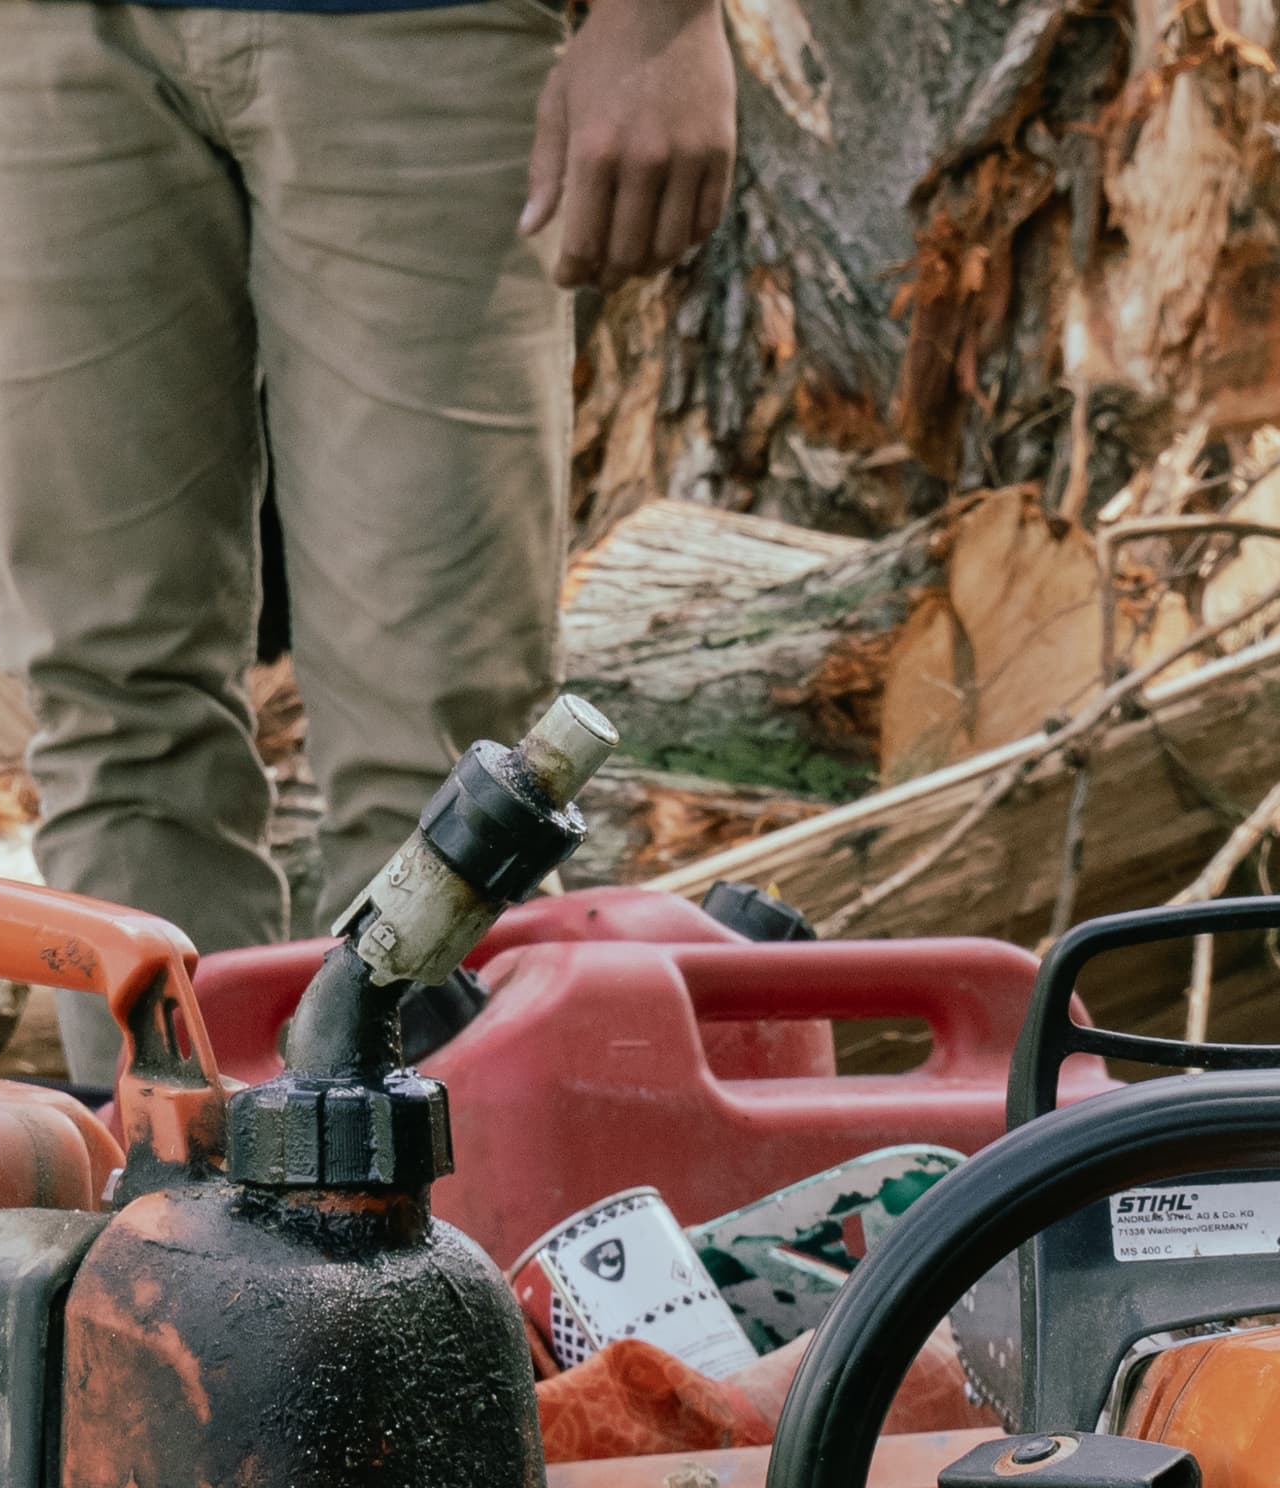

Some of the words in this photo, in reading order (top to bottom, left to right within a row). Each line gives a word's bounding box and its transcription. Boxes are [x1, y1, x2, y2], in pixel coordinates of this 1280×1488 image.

[1197, 1212, 1210, 1221] AG
[1213, 1212, 1220, 1220] &
[1240, 1209, 1255, 1218] KG
[1120, 1247, 1138, 1257] MS
[1141, 1246, 1162, 1256] 400
[1164, 1245, 1173, 1255] C
